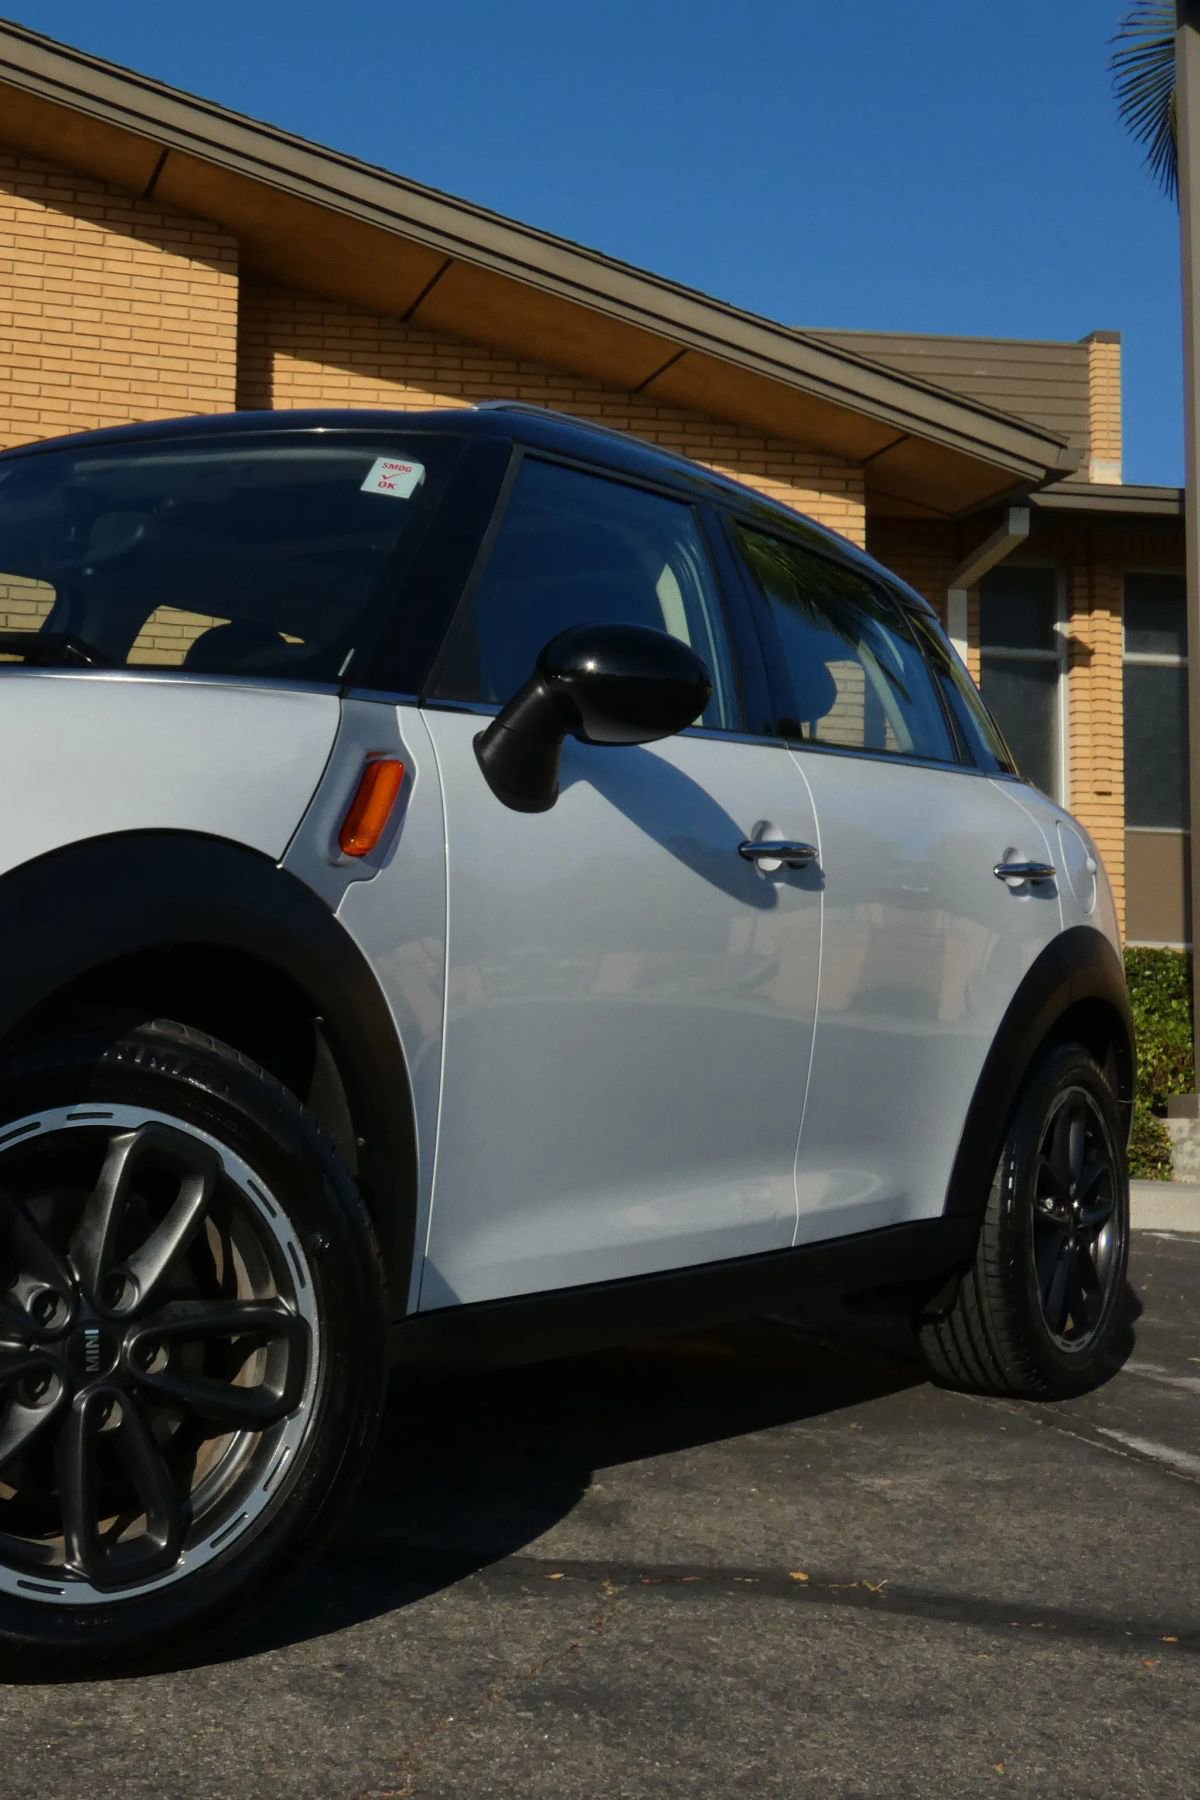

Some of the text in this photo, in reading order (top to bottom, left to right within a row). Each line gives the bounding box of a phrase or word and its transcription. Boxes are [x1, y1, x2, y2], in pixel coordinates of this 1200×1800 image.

[381, 462, 413, 473] SMOG
[377, 480, 397, 490] OK
[84, 1329, 100, 1372] MINI
